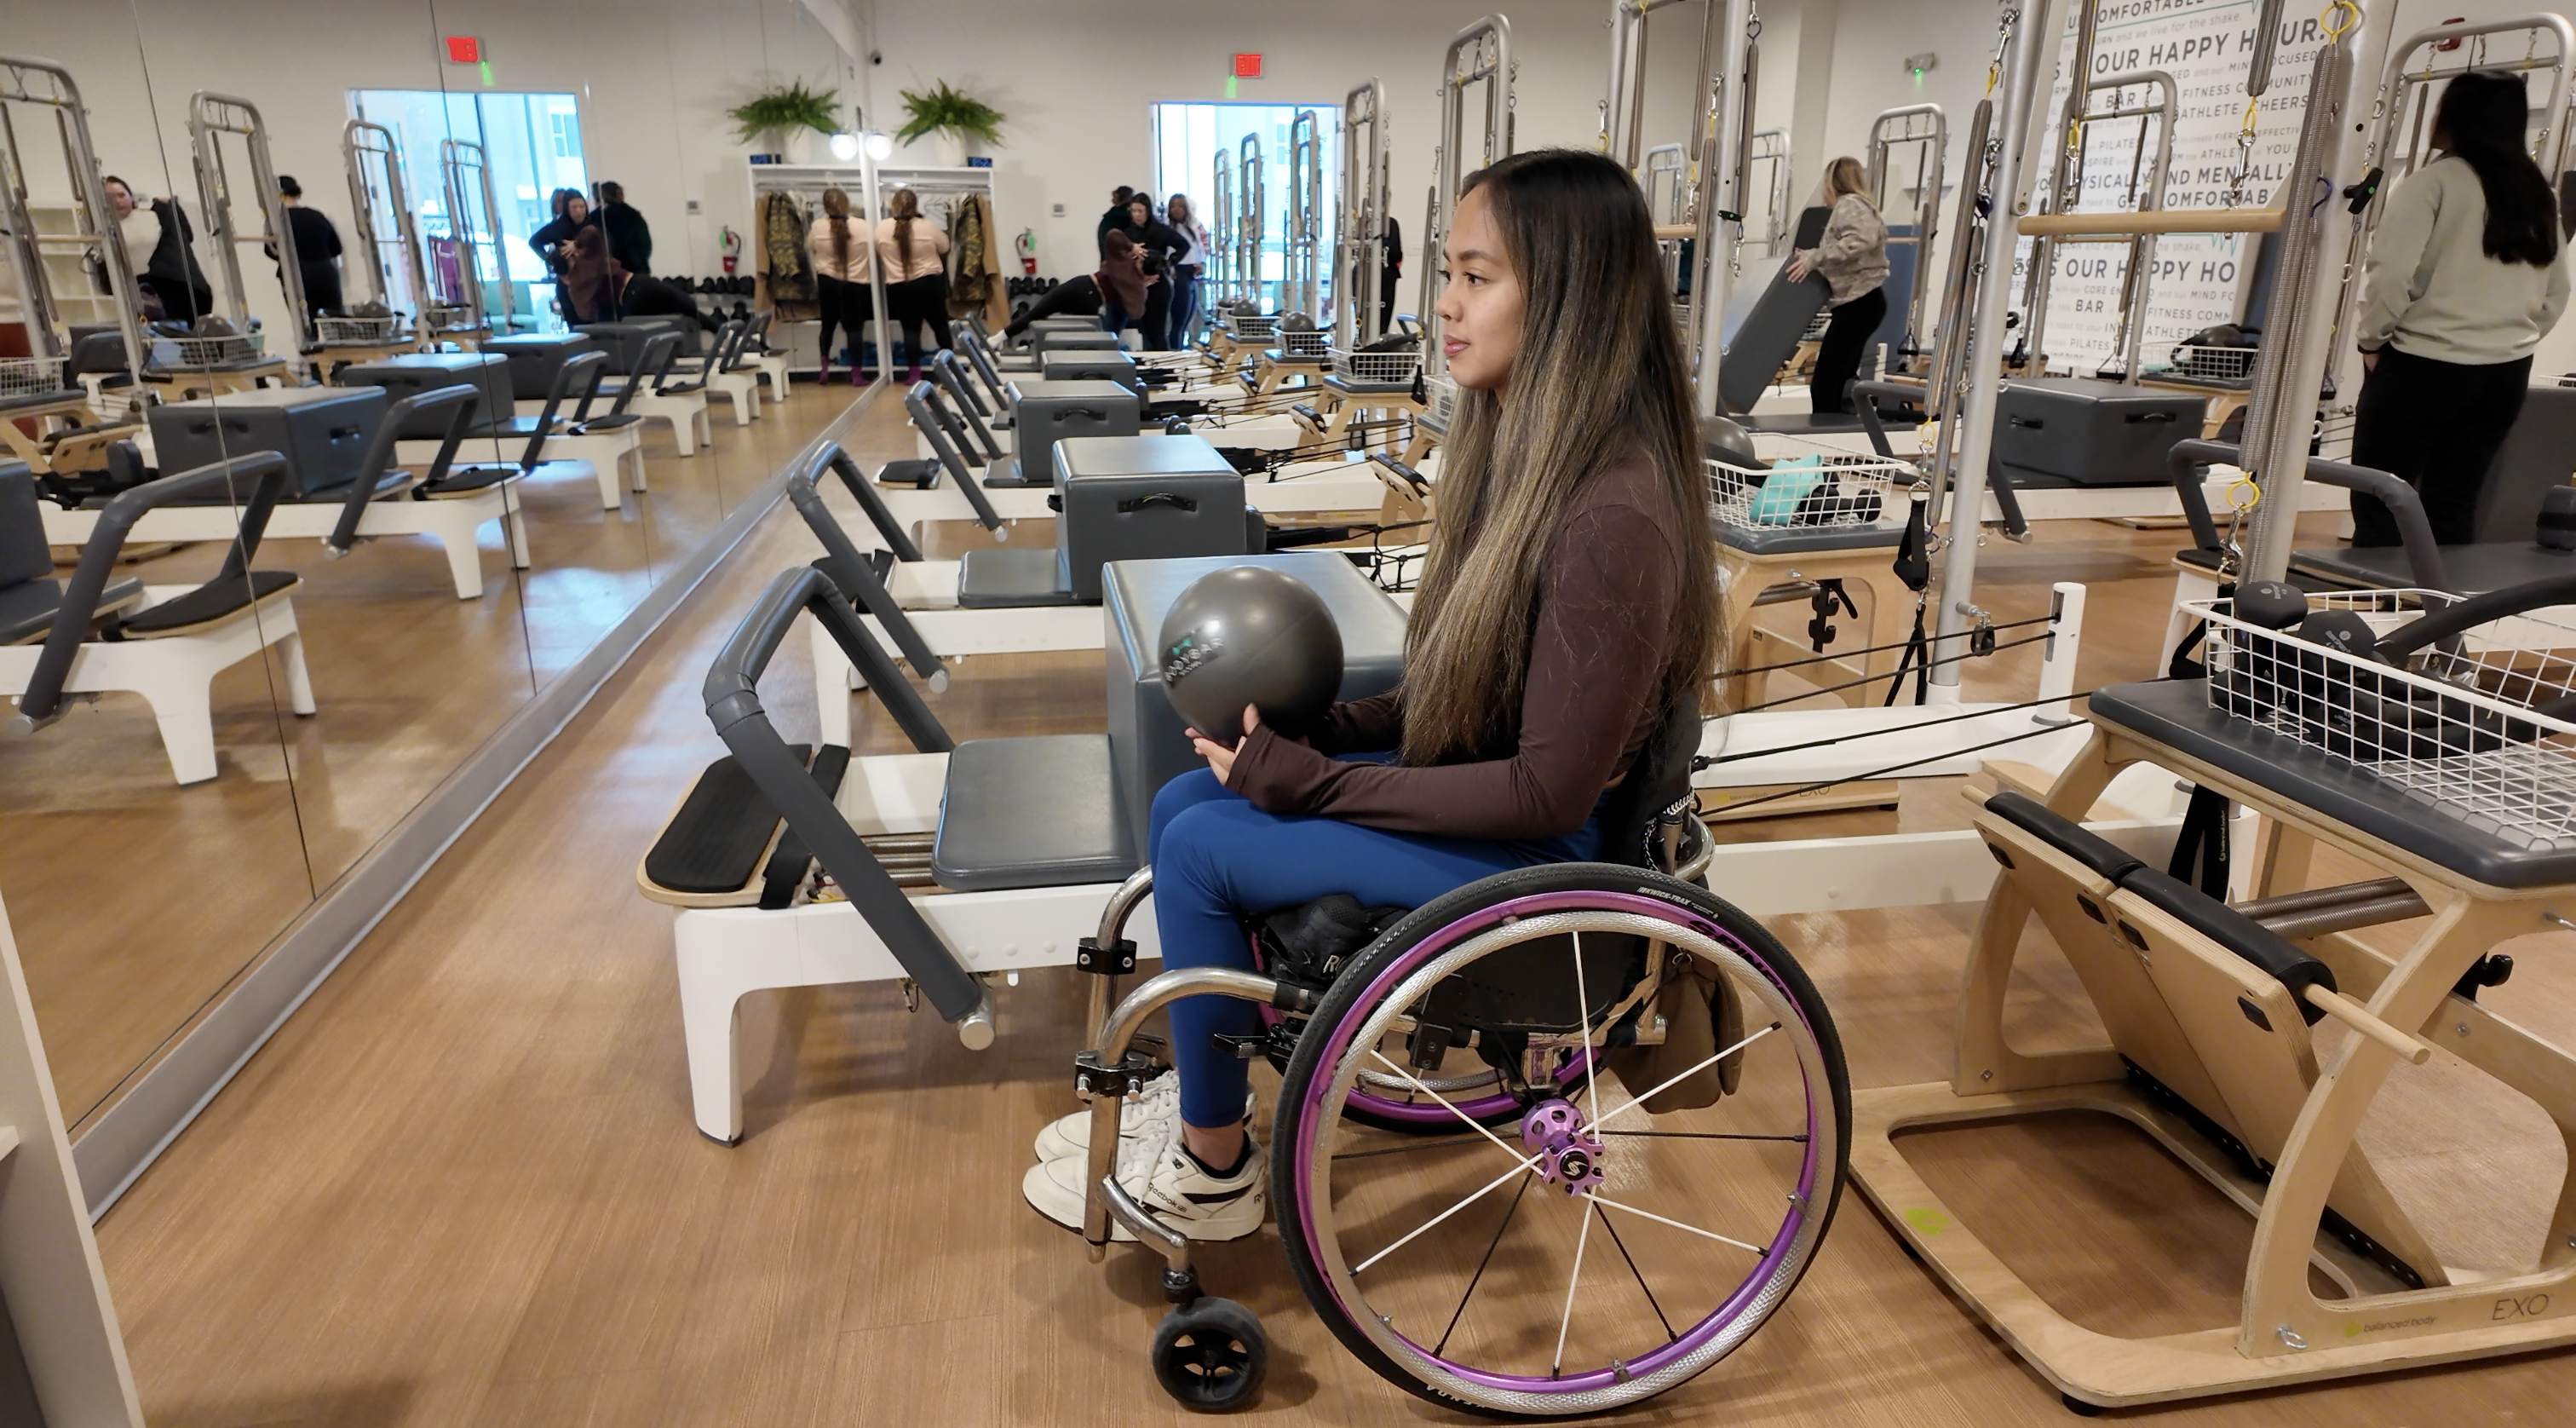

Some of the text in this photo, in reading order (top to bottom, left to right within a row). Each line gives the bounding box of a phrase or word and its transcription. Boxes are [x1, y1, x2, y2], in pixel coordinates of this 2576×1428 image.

[2189, 18, 2206, 30] the
[2096, 48, 2140, 74] OUR
[2148, 32, 2230, 66] HAPPY
[2239, 18, 2326, 53] HUR.
[2228, 60, 2251, 72] MIN
[2105, 92, 2136, 109] BAR
[2182, 83, 2231, 100] FITNESS
[2180, 102, 2243, 120] ATHLETE.
[2256, 95, 2309, 112] HEERS
[2099, 137, 2136, 151] PILATE
[2200, 147, 2241, 159] ATHLET
[2267, 143, 2291, 155] YOU
[2168, 170, 2190, 186] ND
[2118, 193, 2137, 208] GE
[2066, 258, 2107, 279] OUR
[2199, 260, 2236, 283] HO
[2084, 285, 2107, 296] CORE
[2190, 291, 2217, 302] MIND
[2075, 298, 2105, 314] BAR
[2147, 307, 2193, 320] FITNESS
[2069, 337, 2110, 351] PILATES
[1643, 887, 1692, 906] KWICK-TRAX
[1147, 1182, 1178, 1208] Reebok
[2492, 1293, 2550, 1321] EXO
